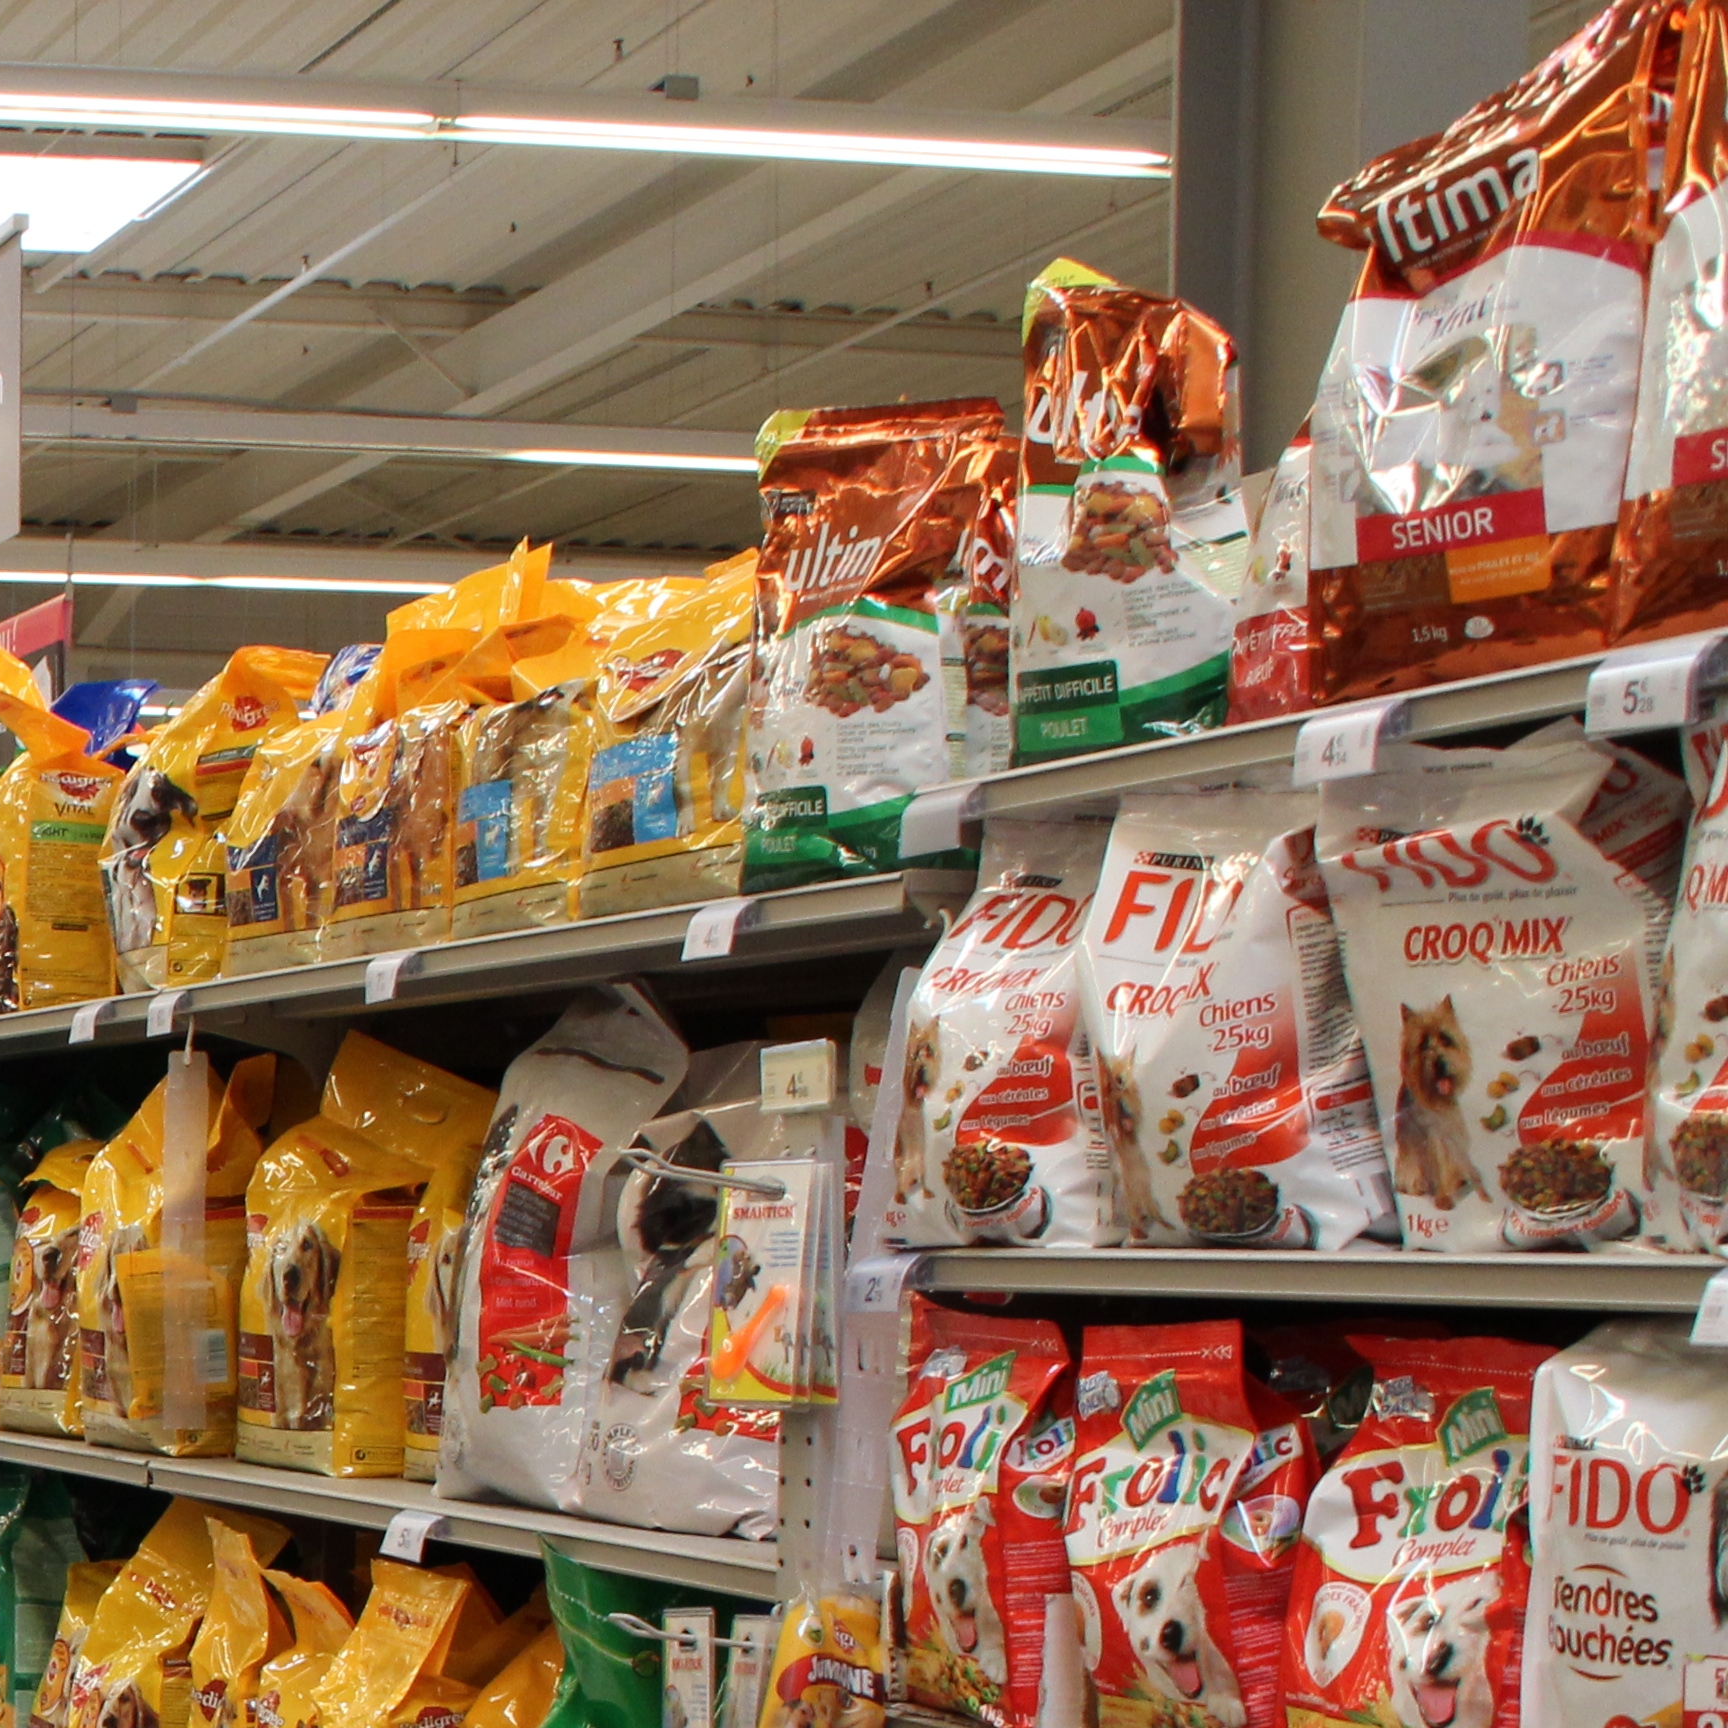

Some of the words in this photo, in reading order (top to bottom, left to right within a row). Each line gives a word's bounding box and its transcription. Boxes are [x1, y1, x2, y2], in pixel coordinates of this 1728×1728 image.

[1376, 149, 1542, 264] ltima
[1391, 507, 1495, 551] SENIOR
[1412, 626, 1433, 644] 1,5
[1434, 625, 1449, 645] kg
[1054, 672, 1115, 699] DIFFICILE
[1041, 716, 1088, 738] POULET
[54, 801, 95, 817] VITAL
[1546, 953, 1621, 989] Chiens
[1004, 990, 1066, 1012] Chiens
[1197, 991, 1277, 1028] Chiens
[1550, 984, 1616, 1017] -25kg
[1003, 1013, 1052, 1036] -25kg
[1206, 1025, 1271, 1053] -25kg
[1560, 1044, 1579, 1061] au
[1578, 1032, 1631, 1059] bœuf
[1011, 1054, 1054, 1077] bœuf
[1212, 1082, 1229, 1098] au
[1228, 1064, 1282, 1095] bœuf
[1566, 1066, 1634, 1094] céréales
[980, 1111, 1031, 1130] légumes
[1543, 1101, 1611, 1126] légumes
[951, 1362, 1008, 1409] Mini
[1126, 1386, 1178, 1443] Mini
[1449, 1406, 1504, 1459] Mini
[1068, 1428, 1232, 1529] Frolic
[1548, 1453, 1692, 1538] FIDO
[1095, 1506, 1169, 1548] Complet
[1391, 1534, 1476, 1569] Complet
[1552, 1575, 1659, 1625] Tendres
